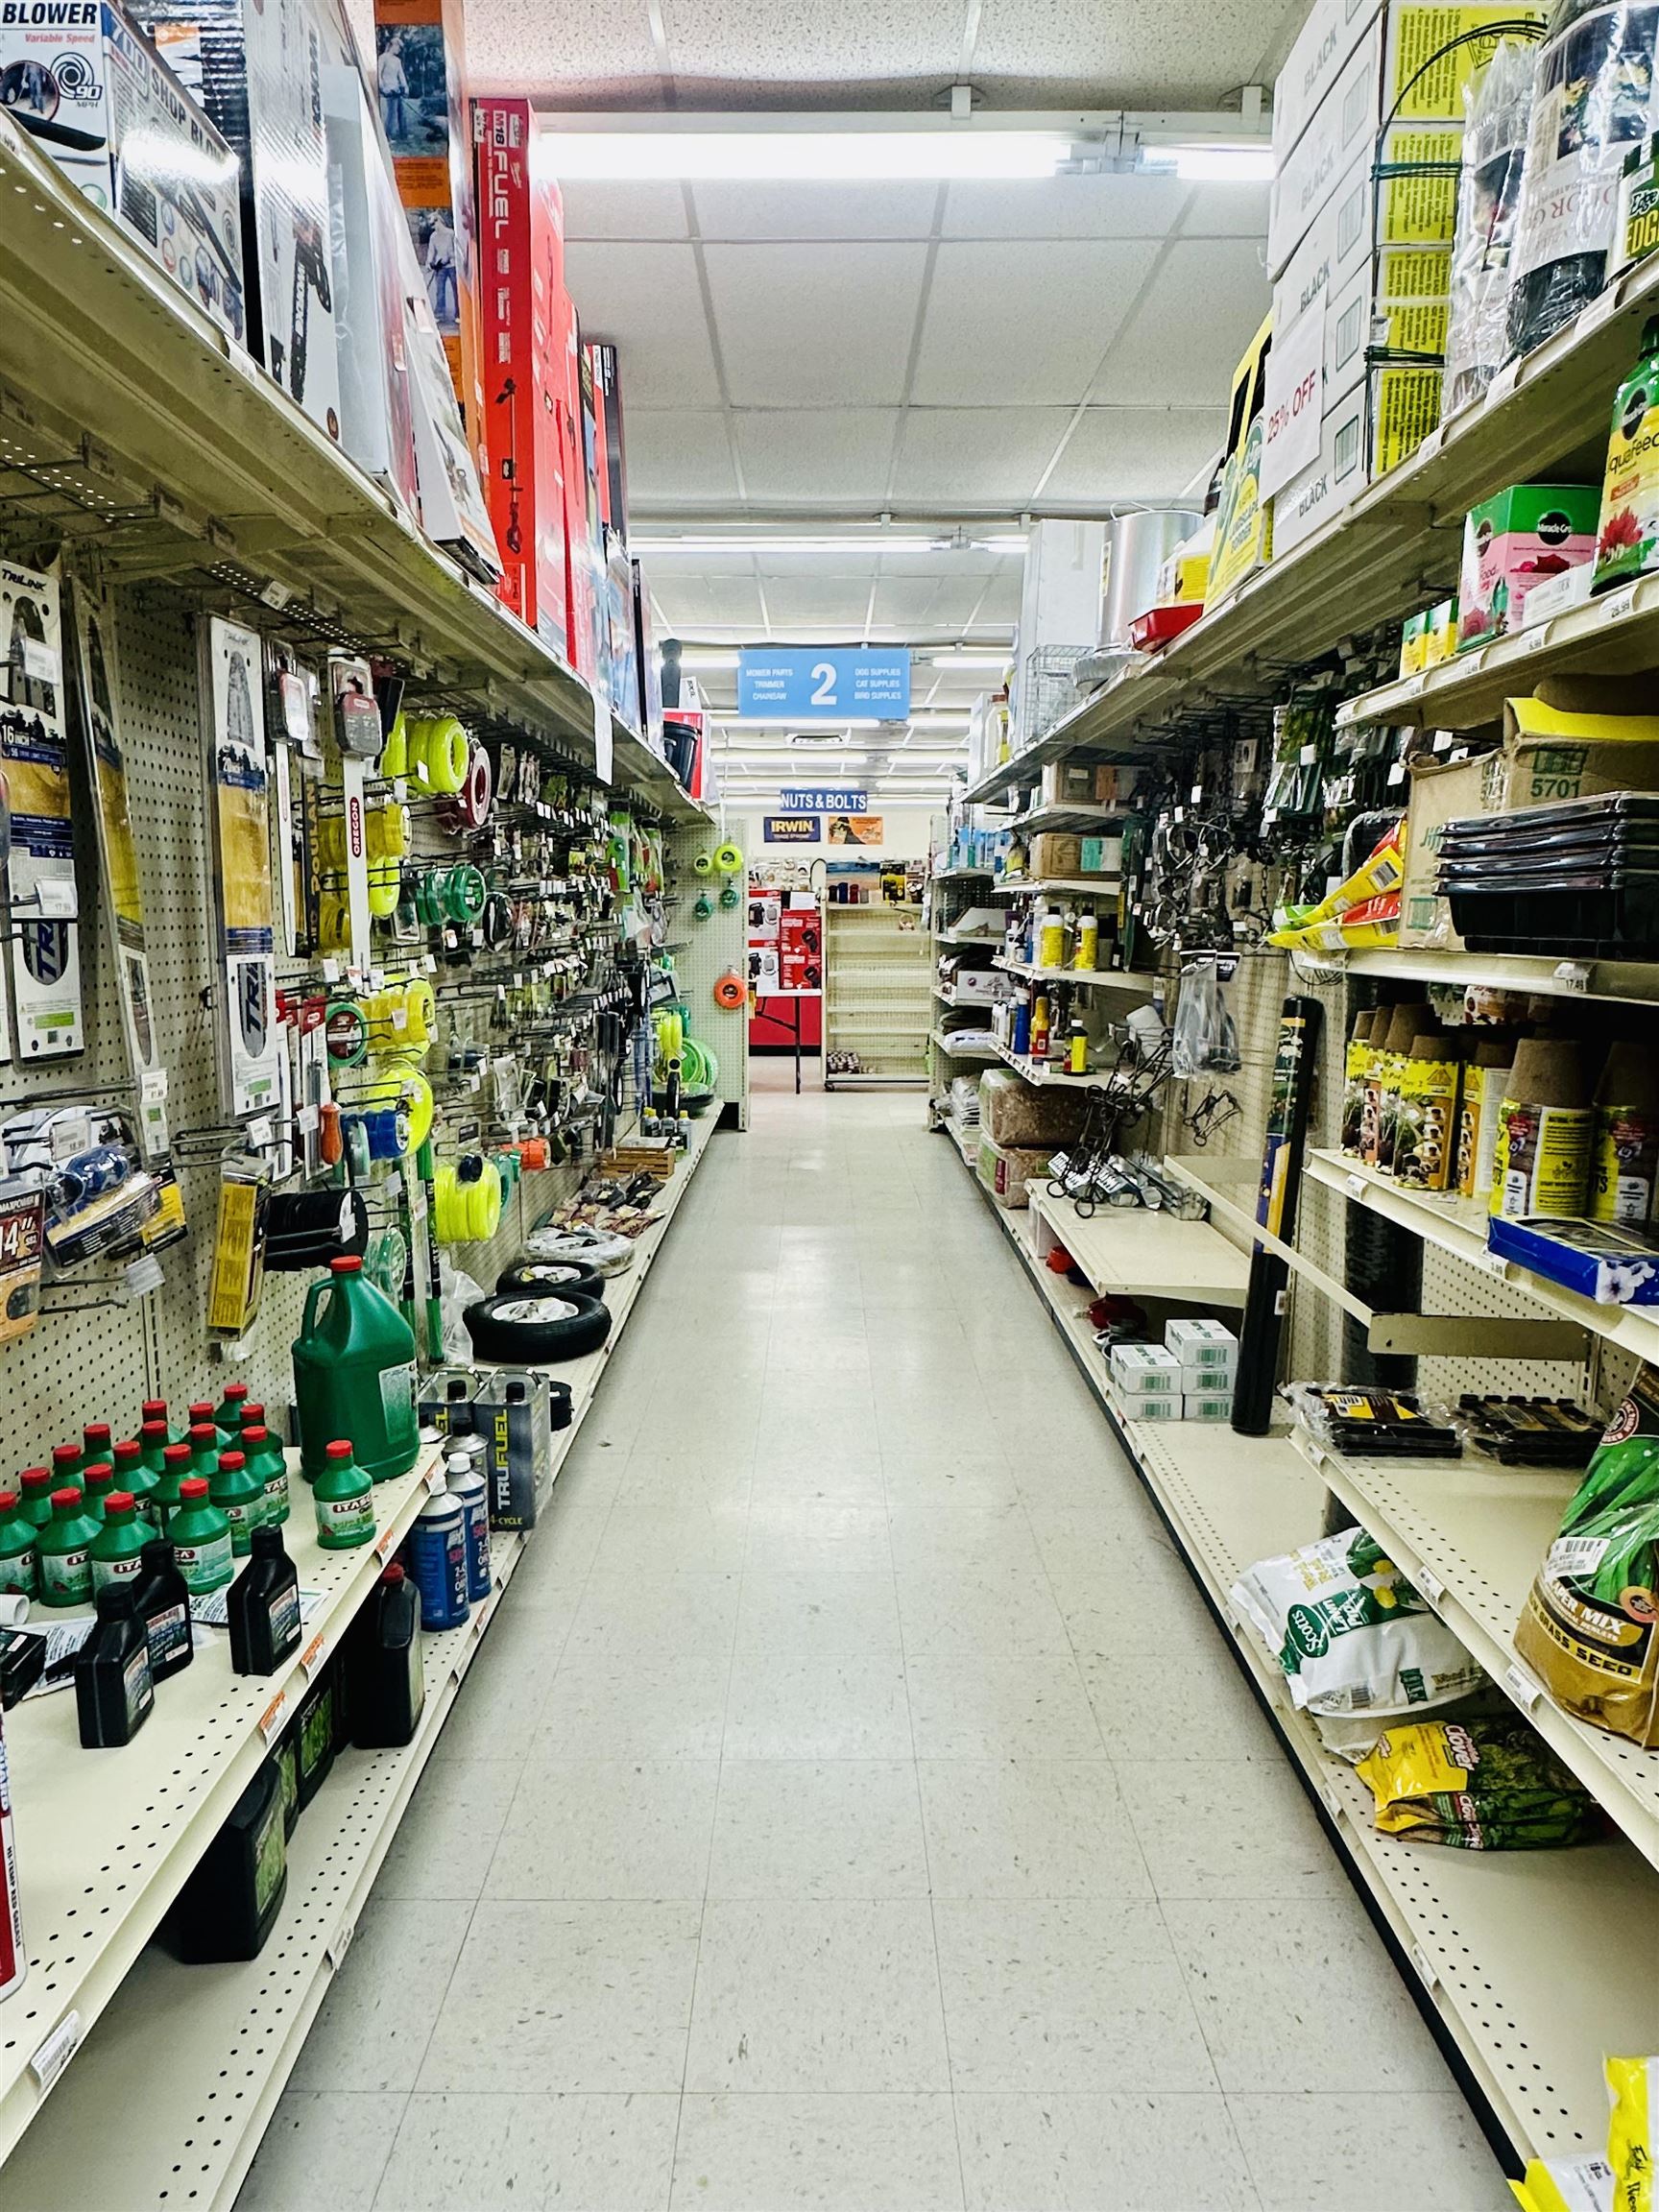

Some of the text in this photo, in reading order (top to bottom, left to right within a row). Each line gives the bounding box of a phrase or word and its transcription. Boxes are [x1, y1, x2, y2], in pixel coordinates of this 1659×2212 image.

[2, 4, 97, 24] BLOWER
[24, 33, 95, 44] Variable Speed
[151, 67, 186, 124] SHOP
[494, 111, 506, 146] M18
[493, 151, 509, 239] FUEL
[1300, 260, 1331, 314] BLACK
[1267, 369, 1316, 445] 25% OFF
[1299, 473, 1328, 517] BLACK
[810, 662, 837, 706] 2
[869, 680, 900, 688] SUPPLIES
[781, 793, 867, 809] NUTS & BOLTS
[1530, 778, 1582, 799] 5701
[351, 801, 361, 854] OREGON
[771, 820, 815, 833] IRWIN
[494, 1408, 511, 1510] TRUFUEL
[1291, 1610, 1320, 1652] Scotts
[1582, 1607, 1627, 1635] MIX
[1539, 1611, 1570, 1649] GRASS
[1575, 1647, 1632, 1676] SEED
[1445, 1724, 1476, 1771] Clover
